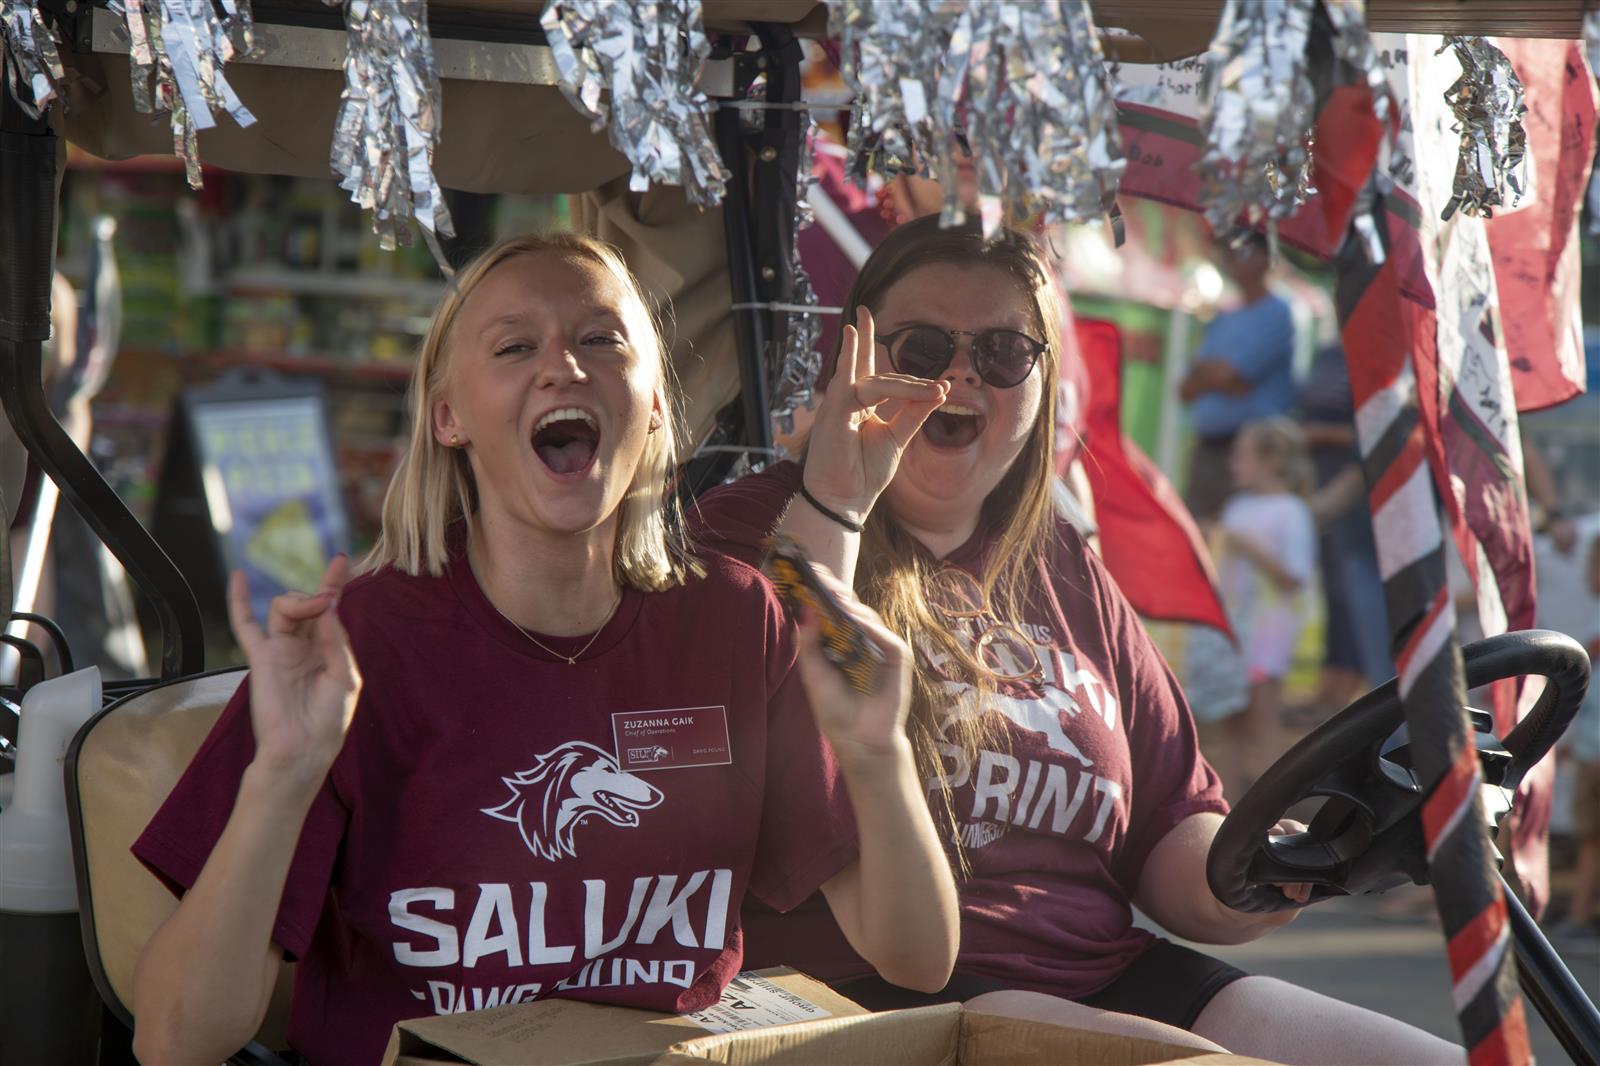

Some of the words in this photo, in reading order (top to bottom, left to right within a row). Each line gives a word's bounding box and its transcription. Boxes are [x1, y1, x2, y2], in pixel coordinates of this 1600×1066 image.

[624, 718, 669, 729] ZUZANNA
[672, 716, 694, 726] GAIK
[388, 868, 733, 969] SALUKI
